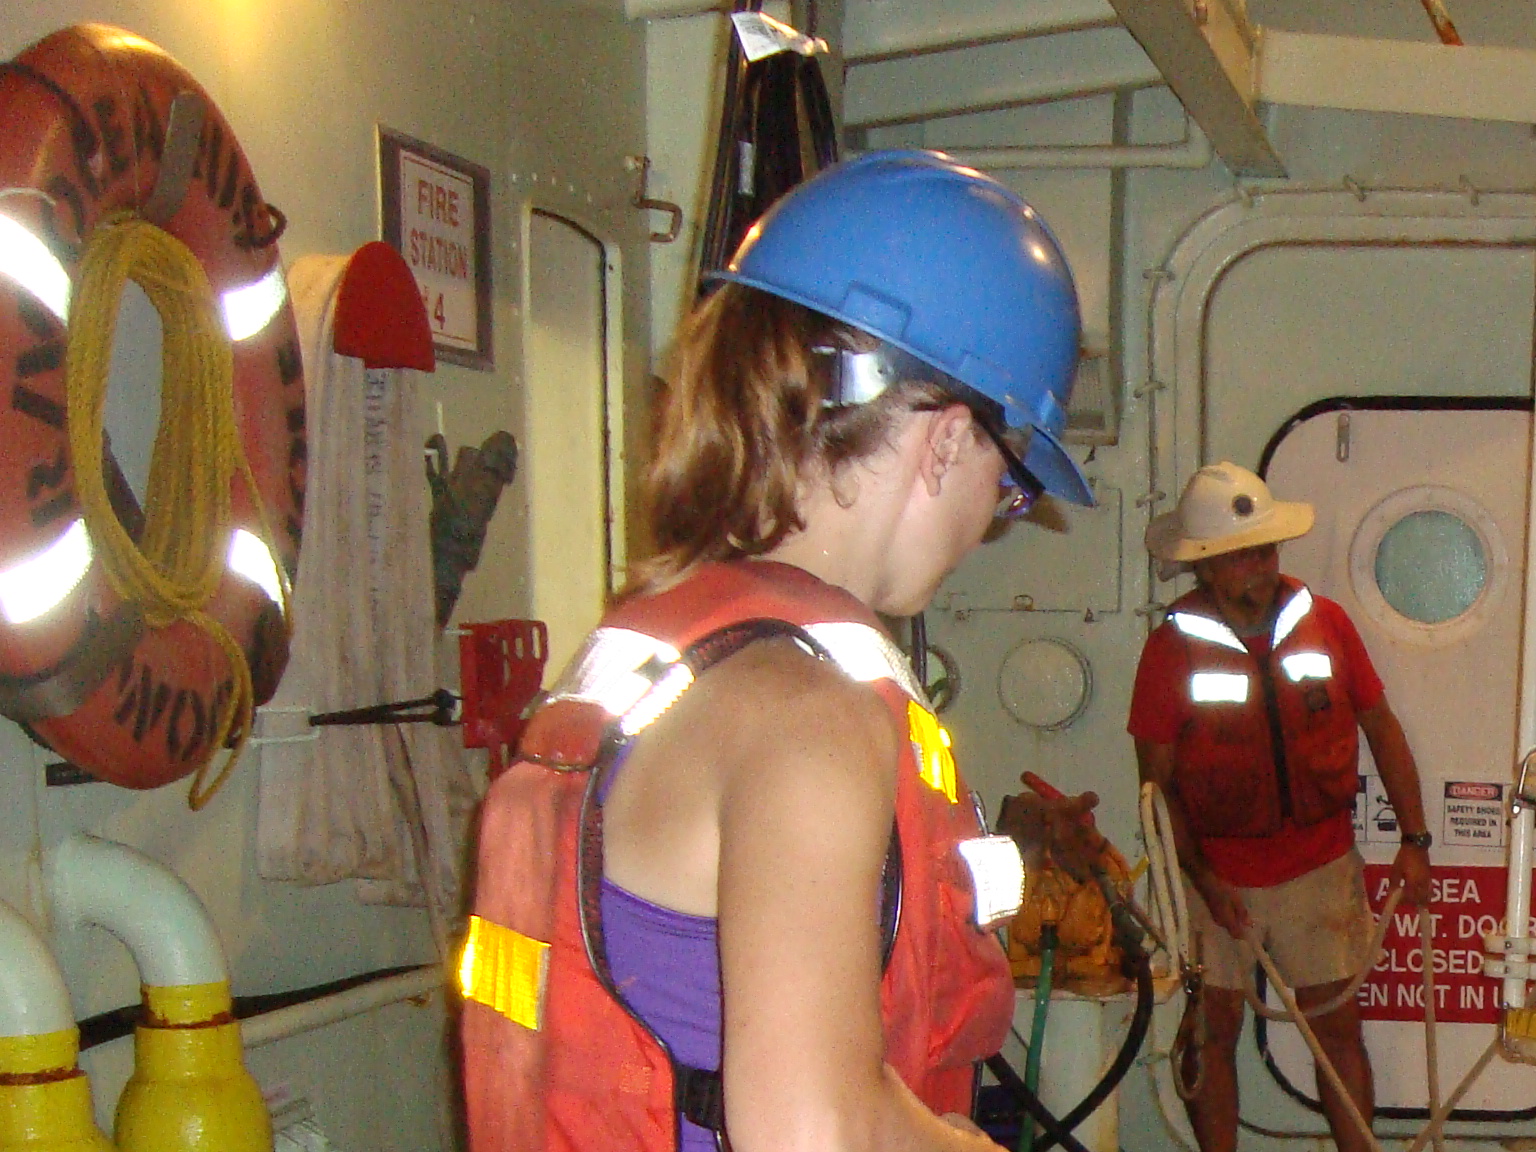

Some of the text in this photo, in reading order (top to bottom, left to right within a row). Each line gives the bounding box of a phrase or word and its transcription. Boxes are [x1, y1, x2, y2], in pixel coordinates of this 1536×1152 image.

[417, 179, 460, 228] FIRE
[410, 227, 468, 279] STATION
[1452, 785, 1495, 797] DANGER
[1373, 948, 1485, 974] CLOSED
[1397, 983, 1451, 1009] NOT
[1460, 985, 1484, 1009] IN
